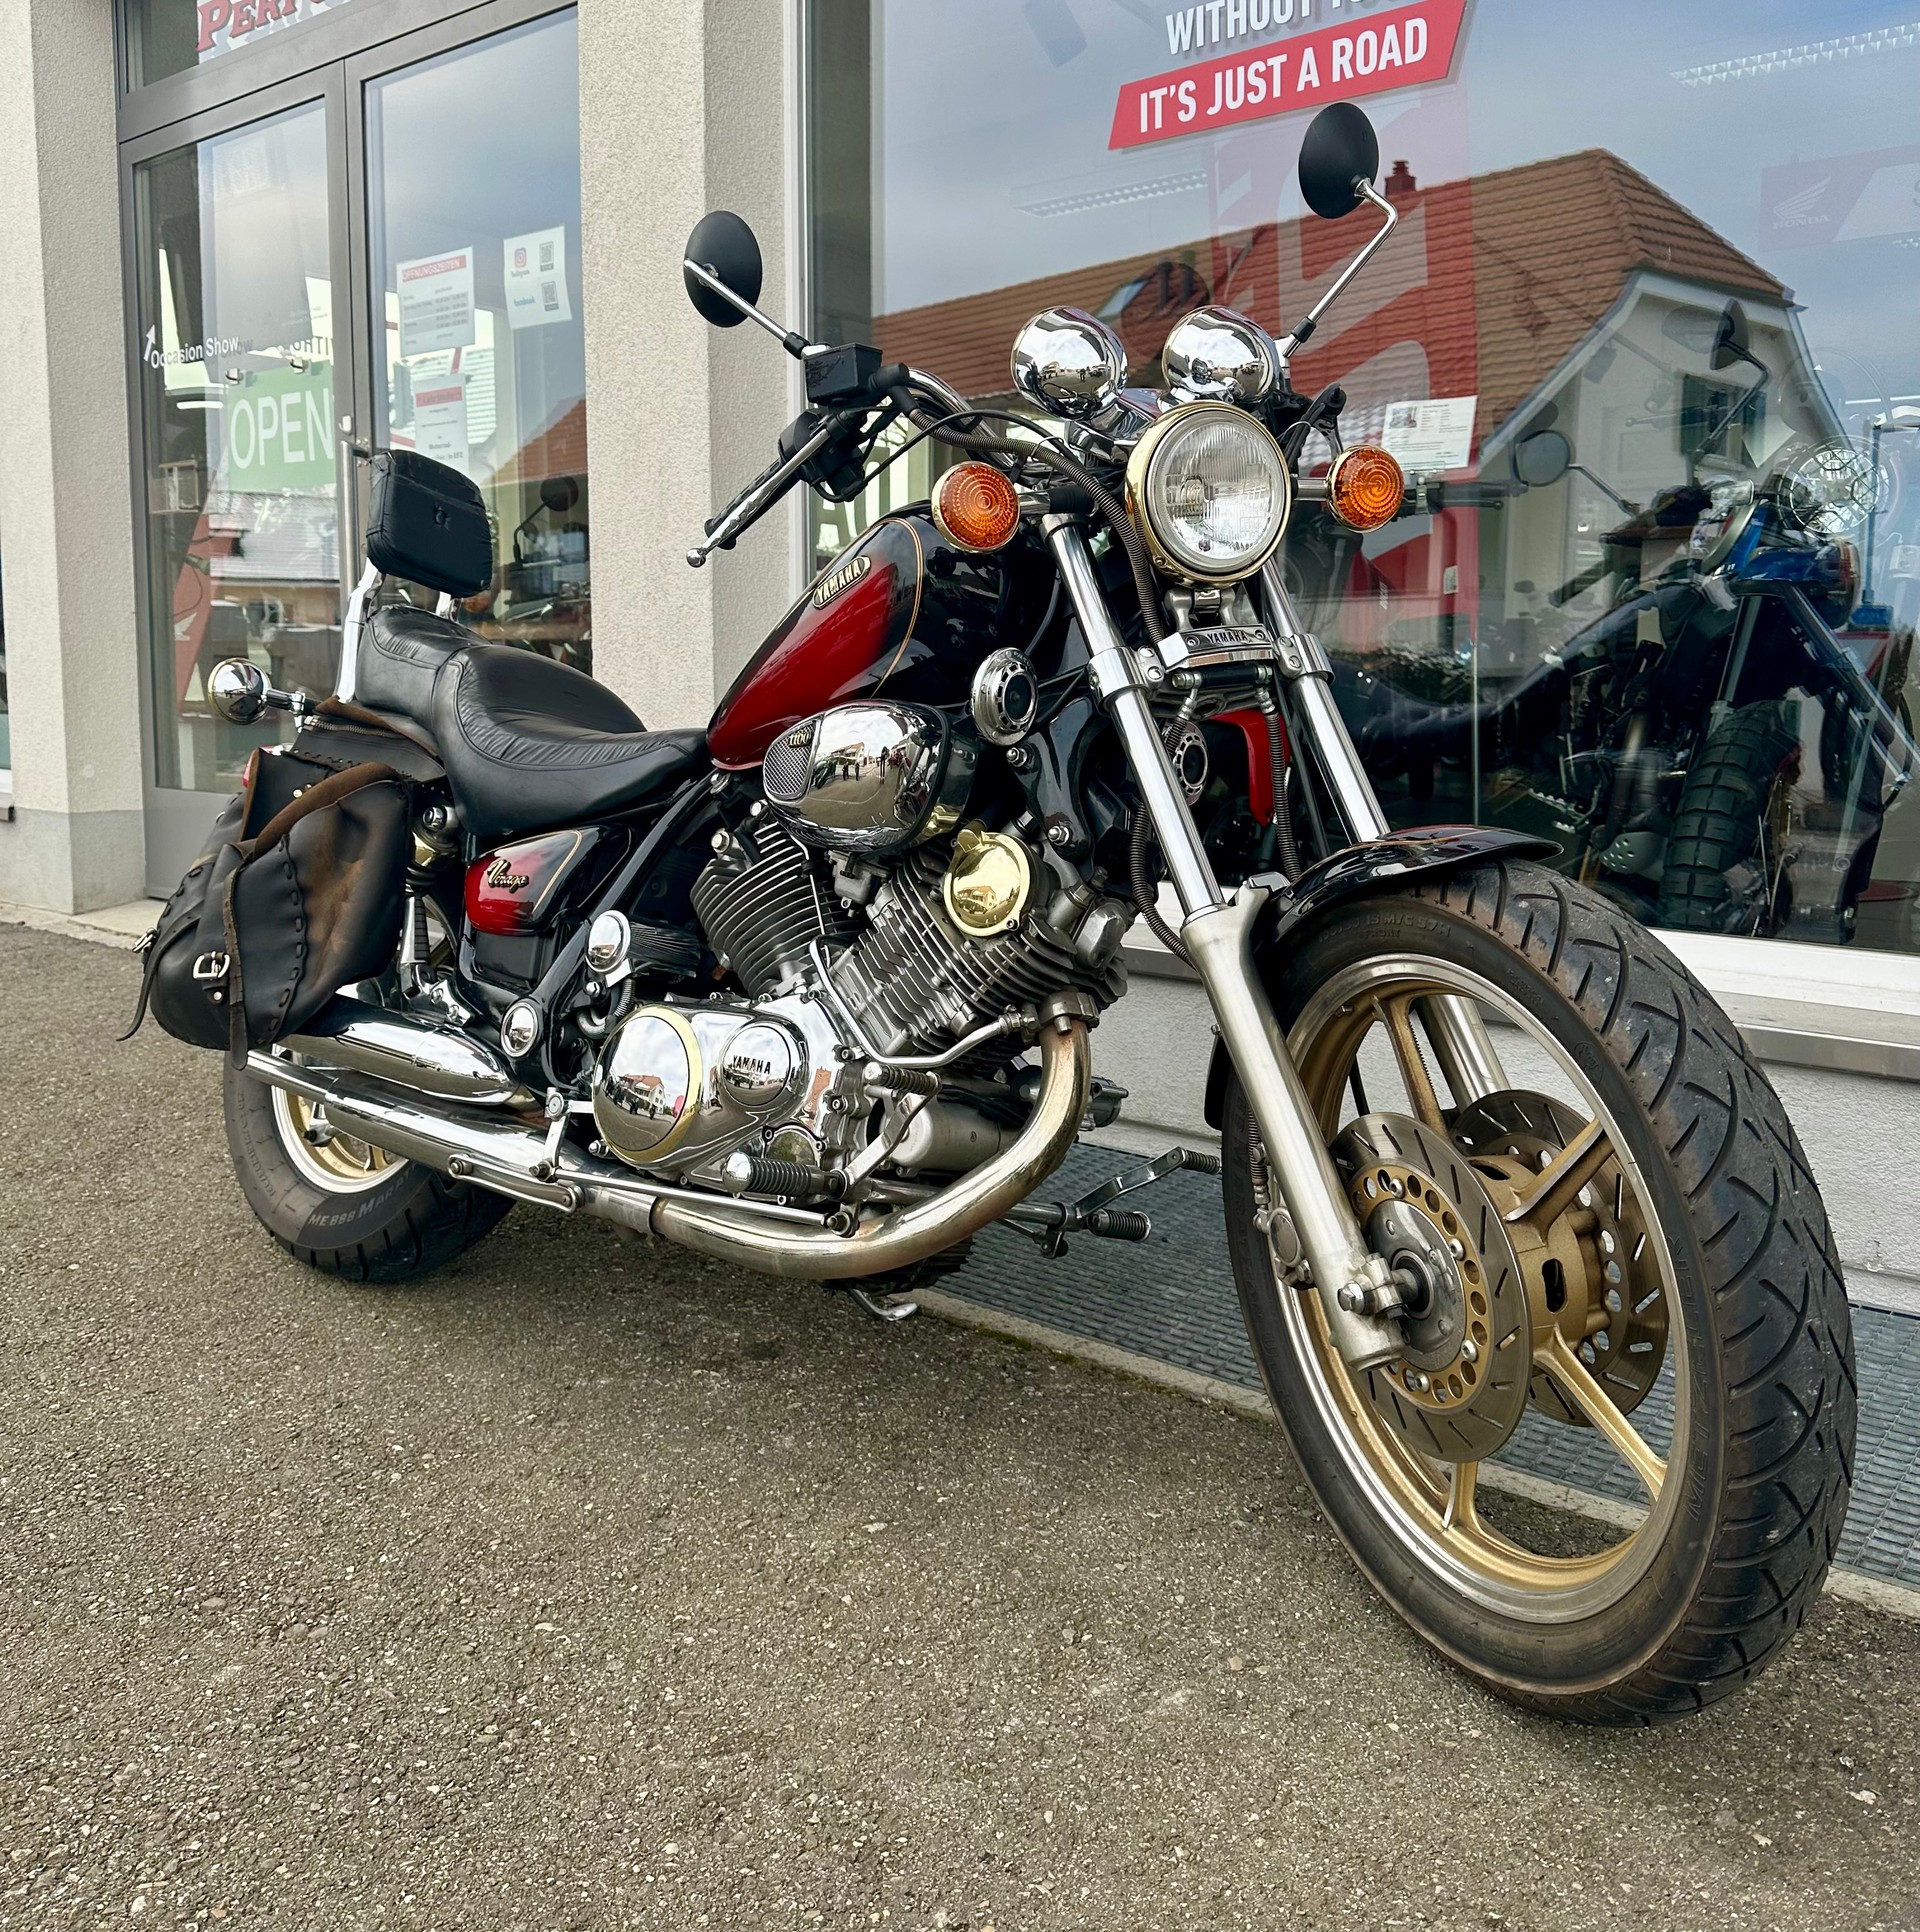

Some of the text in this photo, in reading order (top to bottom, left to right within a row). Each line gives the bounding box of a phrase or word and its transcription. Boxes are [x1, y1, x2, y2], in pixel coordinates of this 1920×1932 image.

[1139, 17, 1428, 133] IT'S JUST A ROAD
[1773, 214, 1831, 231] HONDA
[151, 336, 240, 369] Occasion Show
[230, 388, 335, 469] OPEN
[817, 559, 861, 604] YAMAHA
[1207, 629, 1248, 645] YAMAHA
[789, 731, 809, 747] 1100
[487, 859, 529, 893] Virago
[733, 1055, 771, 1075] YAMAHA
